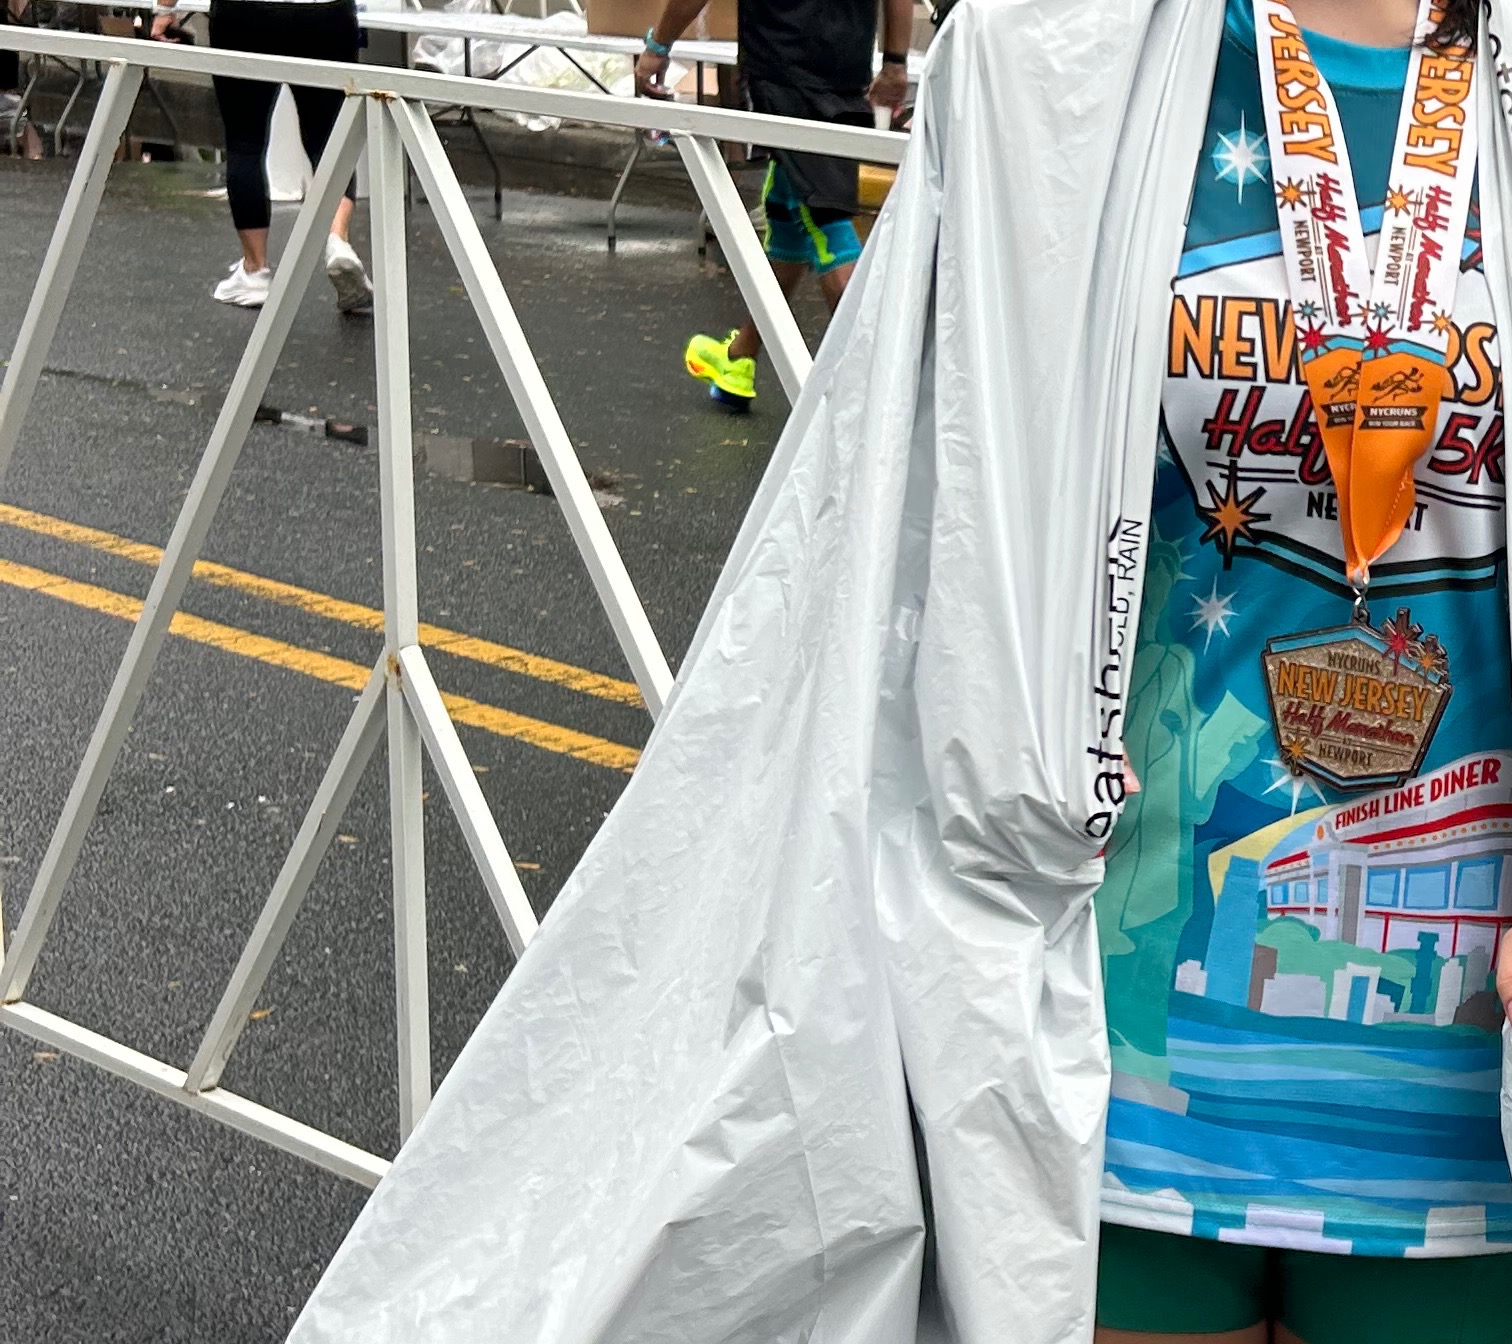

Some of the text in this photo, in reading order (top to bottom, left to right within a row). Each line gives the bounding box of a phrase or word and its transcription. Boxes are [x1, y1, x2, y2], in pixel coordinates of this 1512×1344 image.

[1293, 219, 1317, 283] NEWPORT
[1312, 172, 1359, 328] Half Marathon
[1384, 226, 1407, 286] NEWPORT
[1407, 185, 1452, 333] Half Marathon
[1370, 407, 1418, 416] NYCRUNS
[1427, 412, 1504, 485] 5K
[1117, 519, 1143, 581] RAIN
[1277, 660, 1430, 722] NEW JERSEY
[1327, 650, 1381, 675] NYCRUNS
[1282, 700, 1416, 747] Half Marathon
[1318, 743, 1374, 766] NEWPORT
[1335, 758, 1501, 830] FINISH LINE DINER
